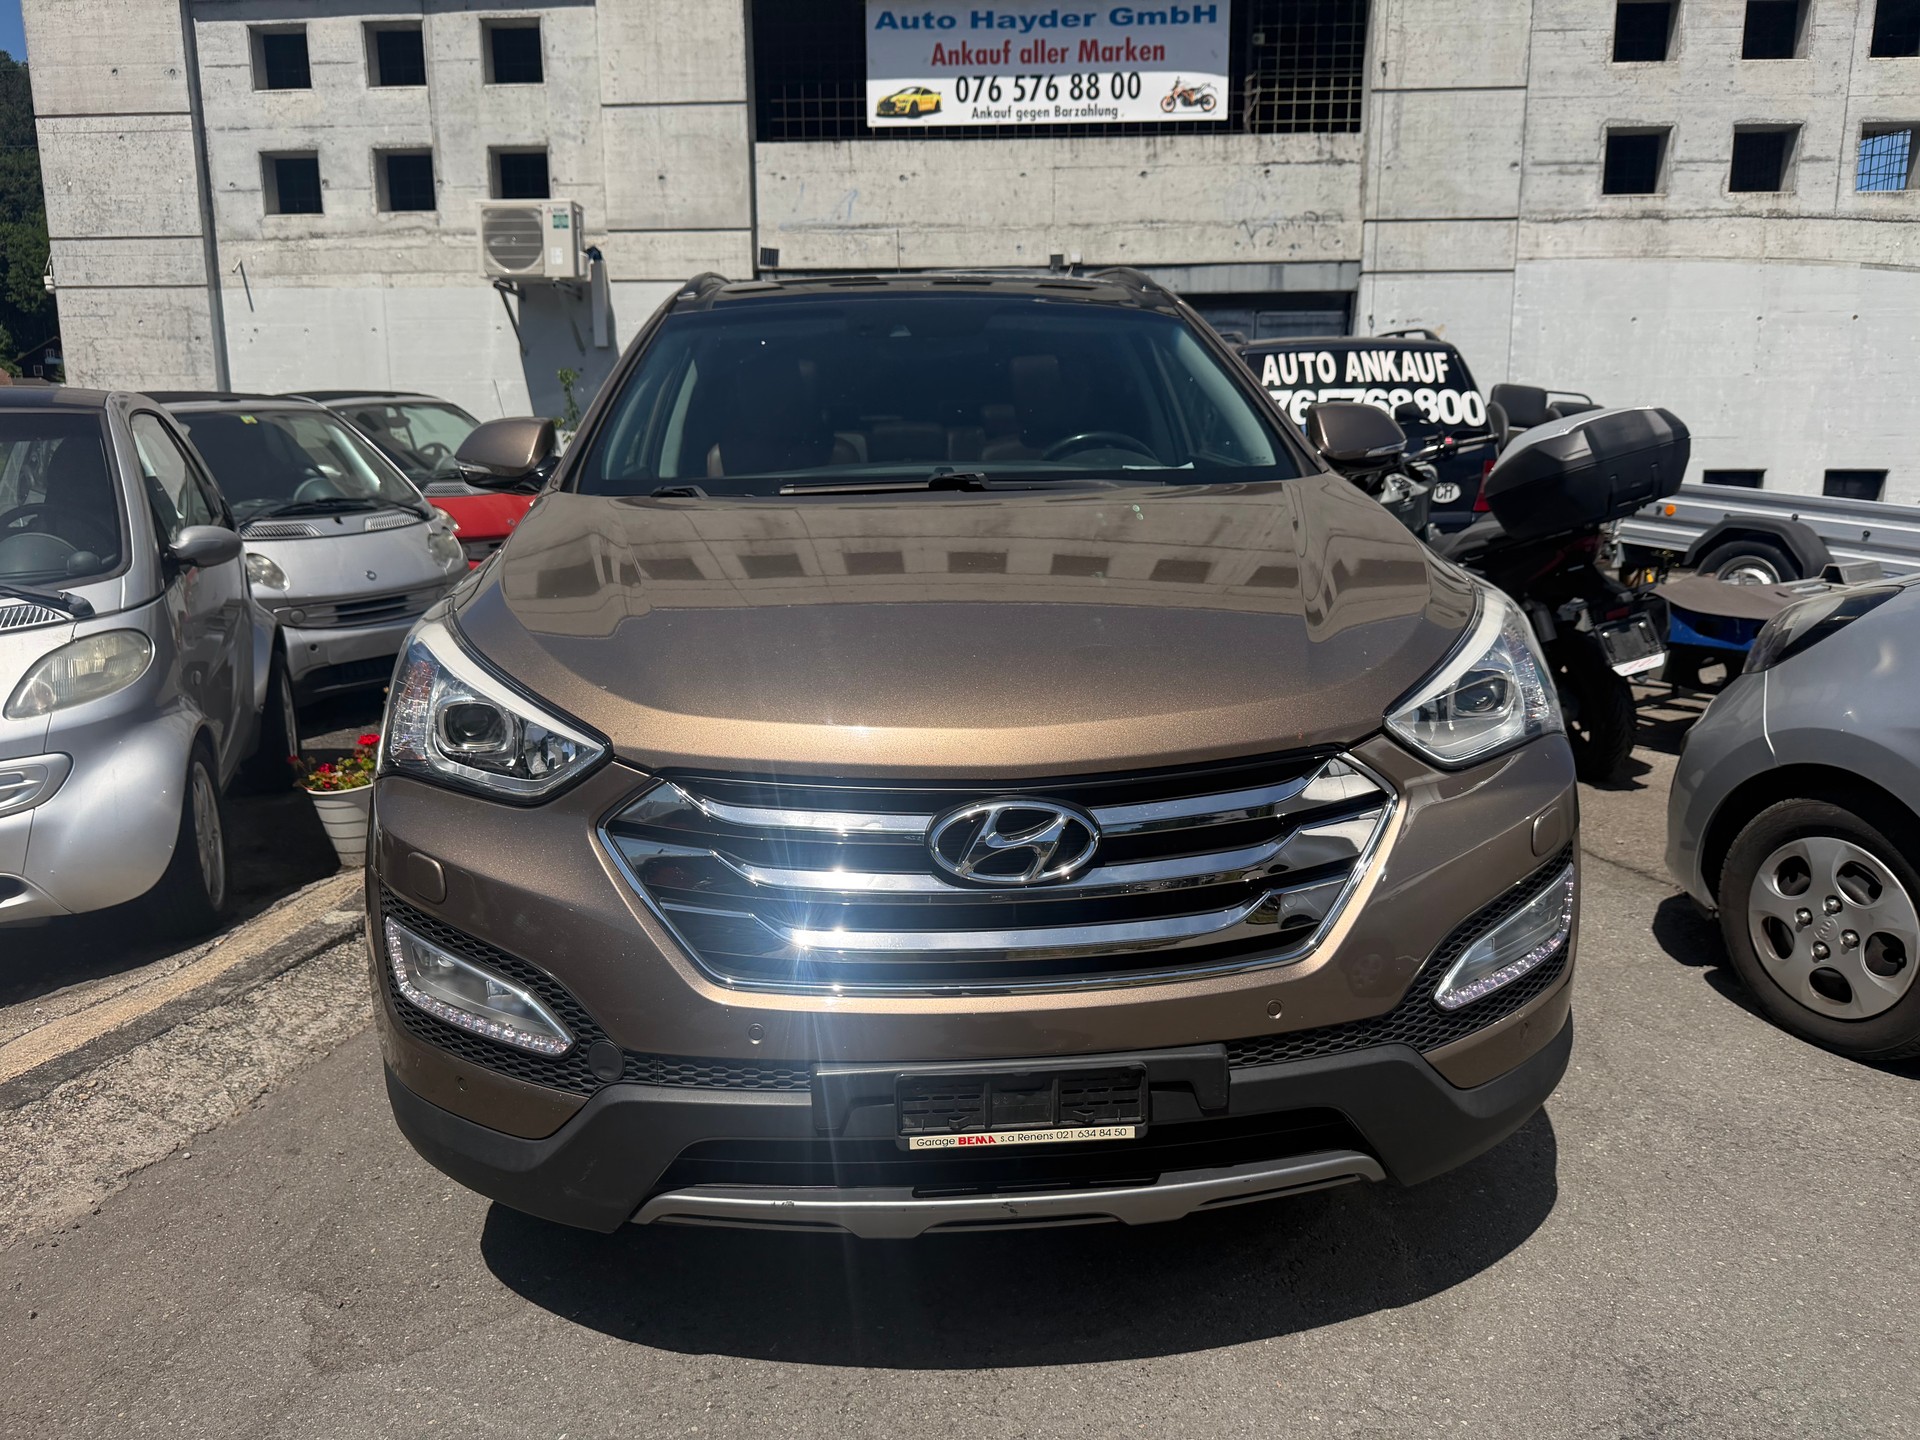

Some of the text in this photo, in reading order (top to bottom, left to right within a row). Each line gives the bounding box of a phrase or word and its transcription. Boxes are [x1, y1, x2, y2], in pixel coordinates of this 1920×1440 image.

[874, 4, 1218, 34] Auto Hayder GmbH
[931, 36, 1166, 66] Ankauf aller Marken
[955, 71, 1142, 104] 076 576 88 00
[971, 104, 1118, 121] Ankauf gegen Barzahlung
[1261, 350, 1450, 387] AUTO ANKAUF
[1435, 485, 1455, 500] CH
[916, 1138, 956, 1148] Garage
[958, 1135, 997, 1146] BEMA
[1017, 1132, 1054, 1142] Renens
[1056, 1130, 1074, 1140] 021
[1077, 1129, 1096, 1139] 634
[1098, 1128, 1112, 1138] 84
[1114, 1127, 1127, 1137] 50
